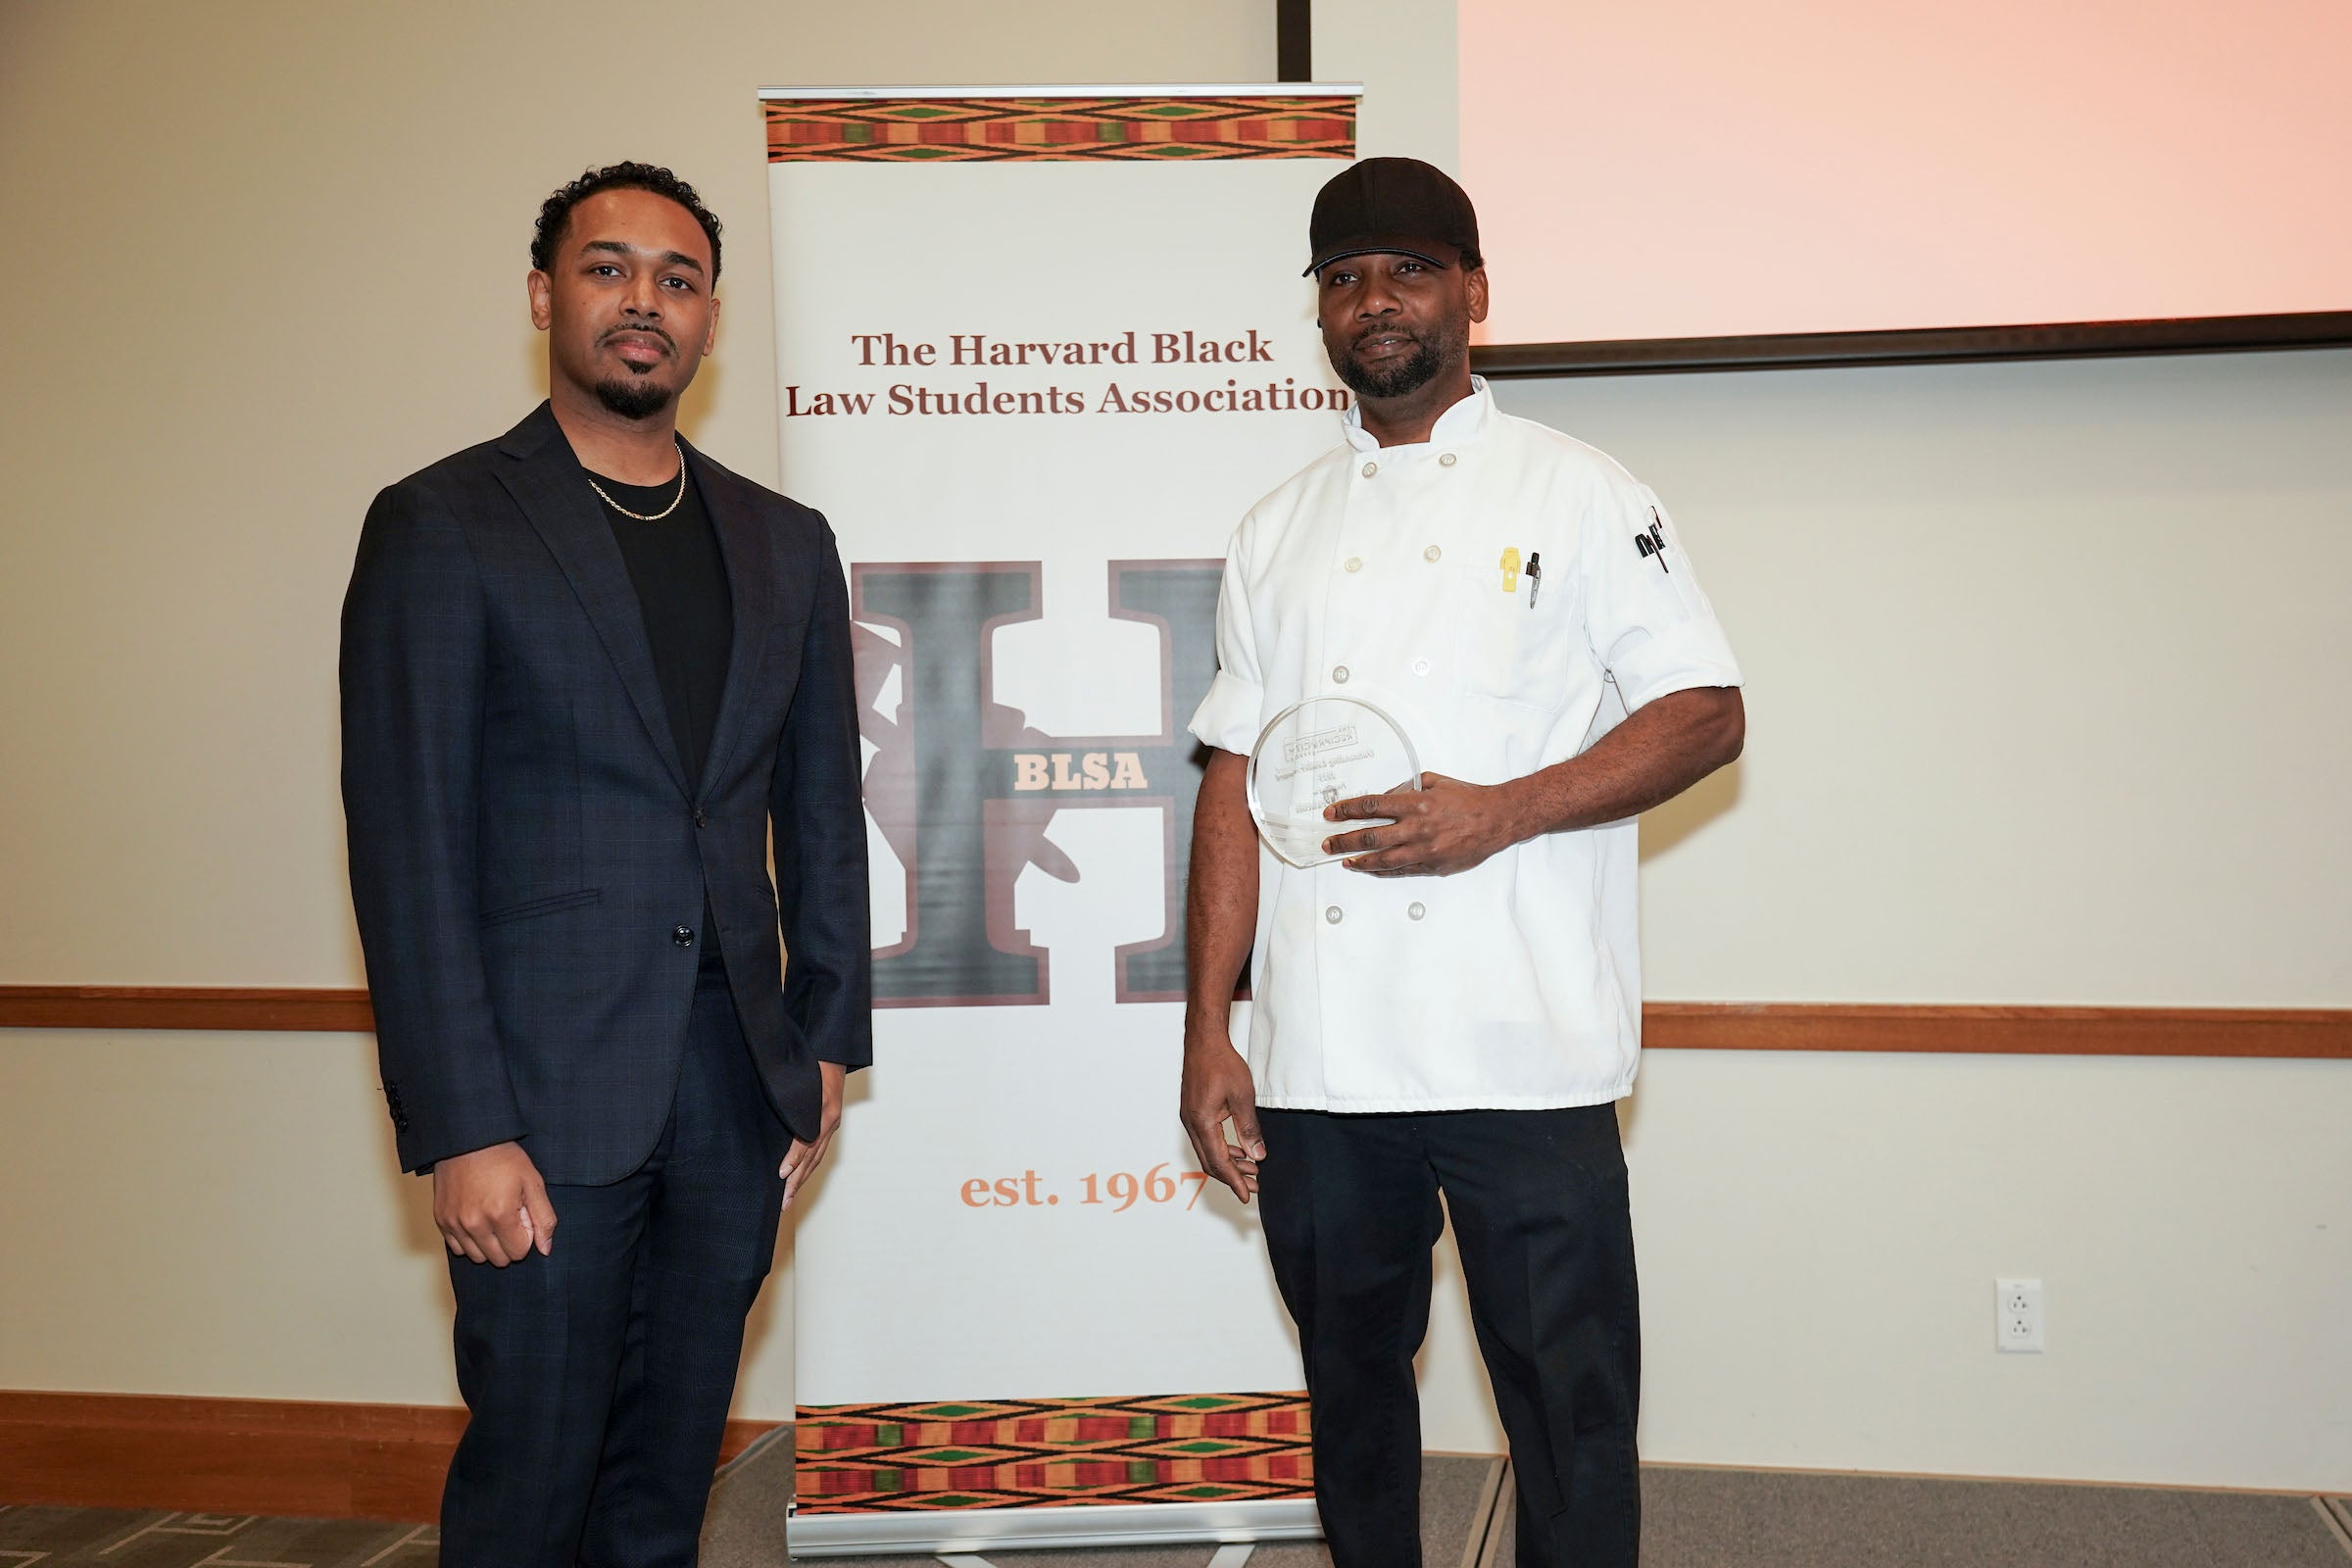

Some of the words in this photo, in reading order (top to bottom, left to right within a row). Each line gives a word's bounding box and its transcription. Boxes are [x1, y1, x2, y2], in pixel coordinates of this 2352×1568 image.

[851, 332, 937, 367] The
[949, 331, 1139, 367] Harvard
[1151, 328, 1275, 365] Black
[785, 384, 875, 418] Law
[887, 381, 1086, 416] Students
[1096, 377, 1349, 415] Association
[1013, 752, 1149, 791] BLSA
[959, 1169, 1059, 1208] est.
[1079, 1162, 1209, 1214] 1967
